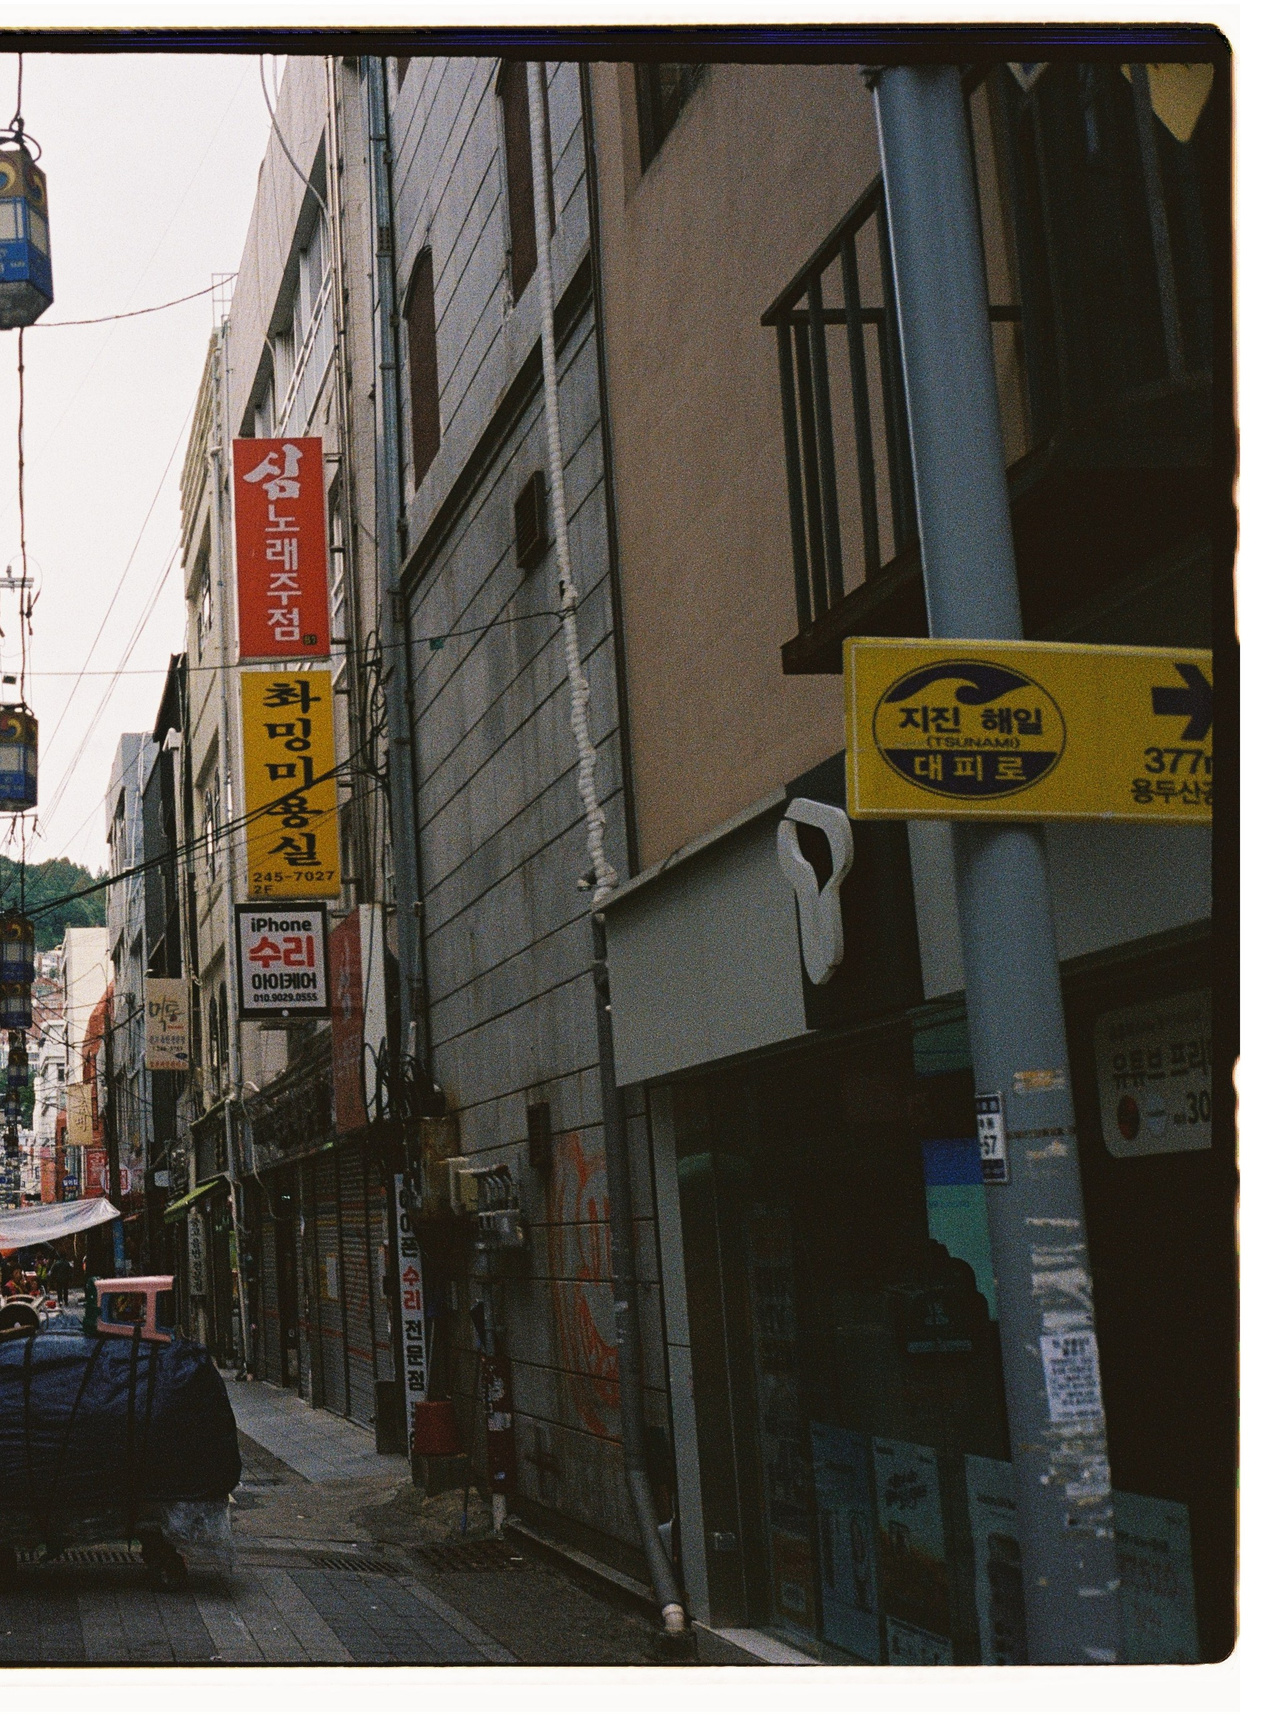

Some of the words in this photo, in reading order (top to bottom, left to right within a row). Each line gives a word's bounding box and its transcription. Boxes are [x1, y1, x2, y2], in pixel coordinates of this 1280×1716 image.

[265, 504, 302, 641] 노래주점
[899, 705, 961, 733] 지진
[981, 707, 1043, 735] 해일
[927, 736, 1020, 749] (TSUNAMI)
[914, 754, 1026, 781] 대피로
[253, 870, 335, 883] 245-7027
[254, 885, 273, 894] 2F
[251, 917, 312, 932] iPhone
[249, 935, 315, 968] 수리
[252, 972, 317, 990] 아이케어
[1170, 1037, 1213, 1077] 프리
